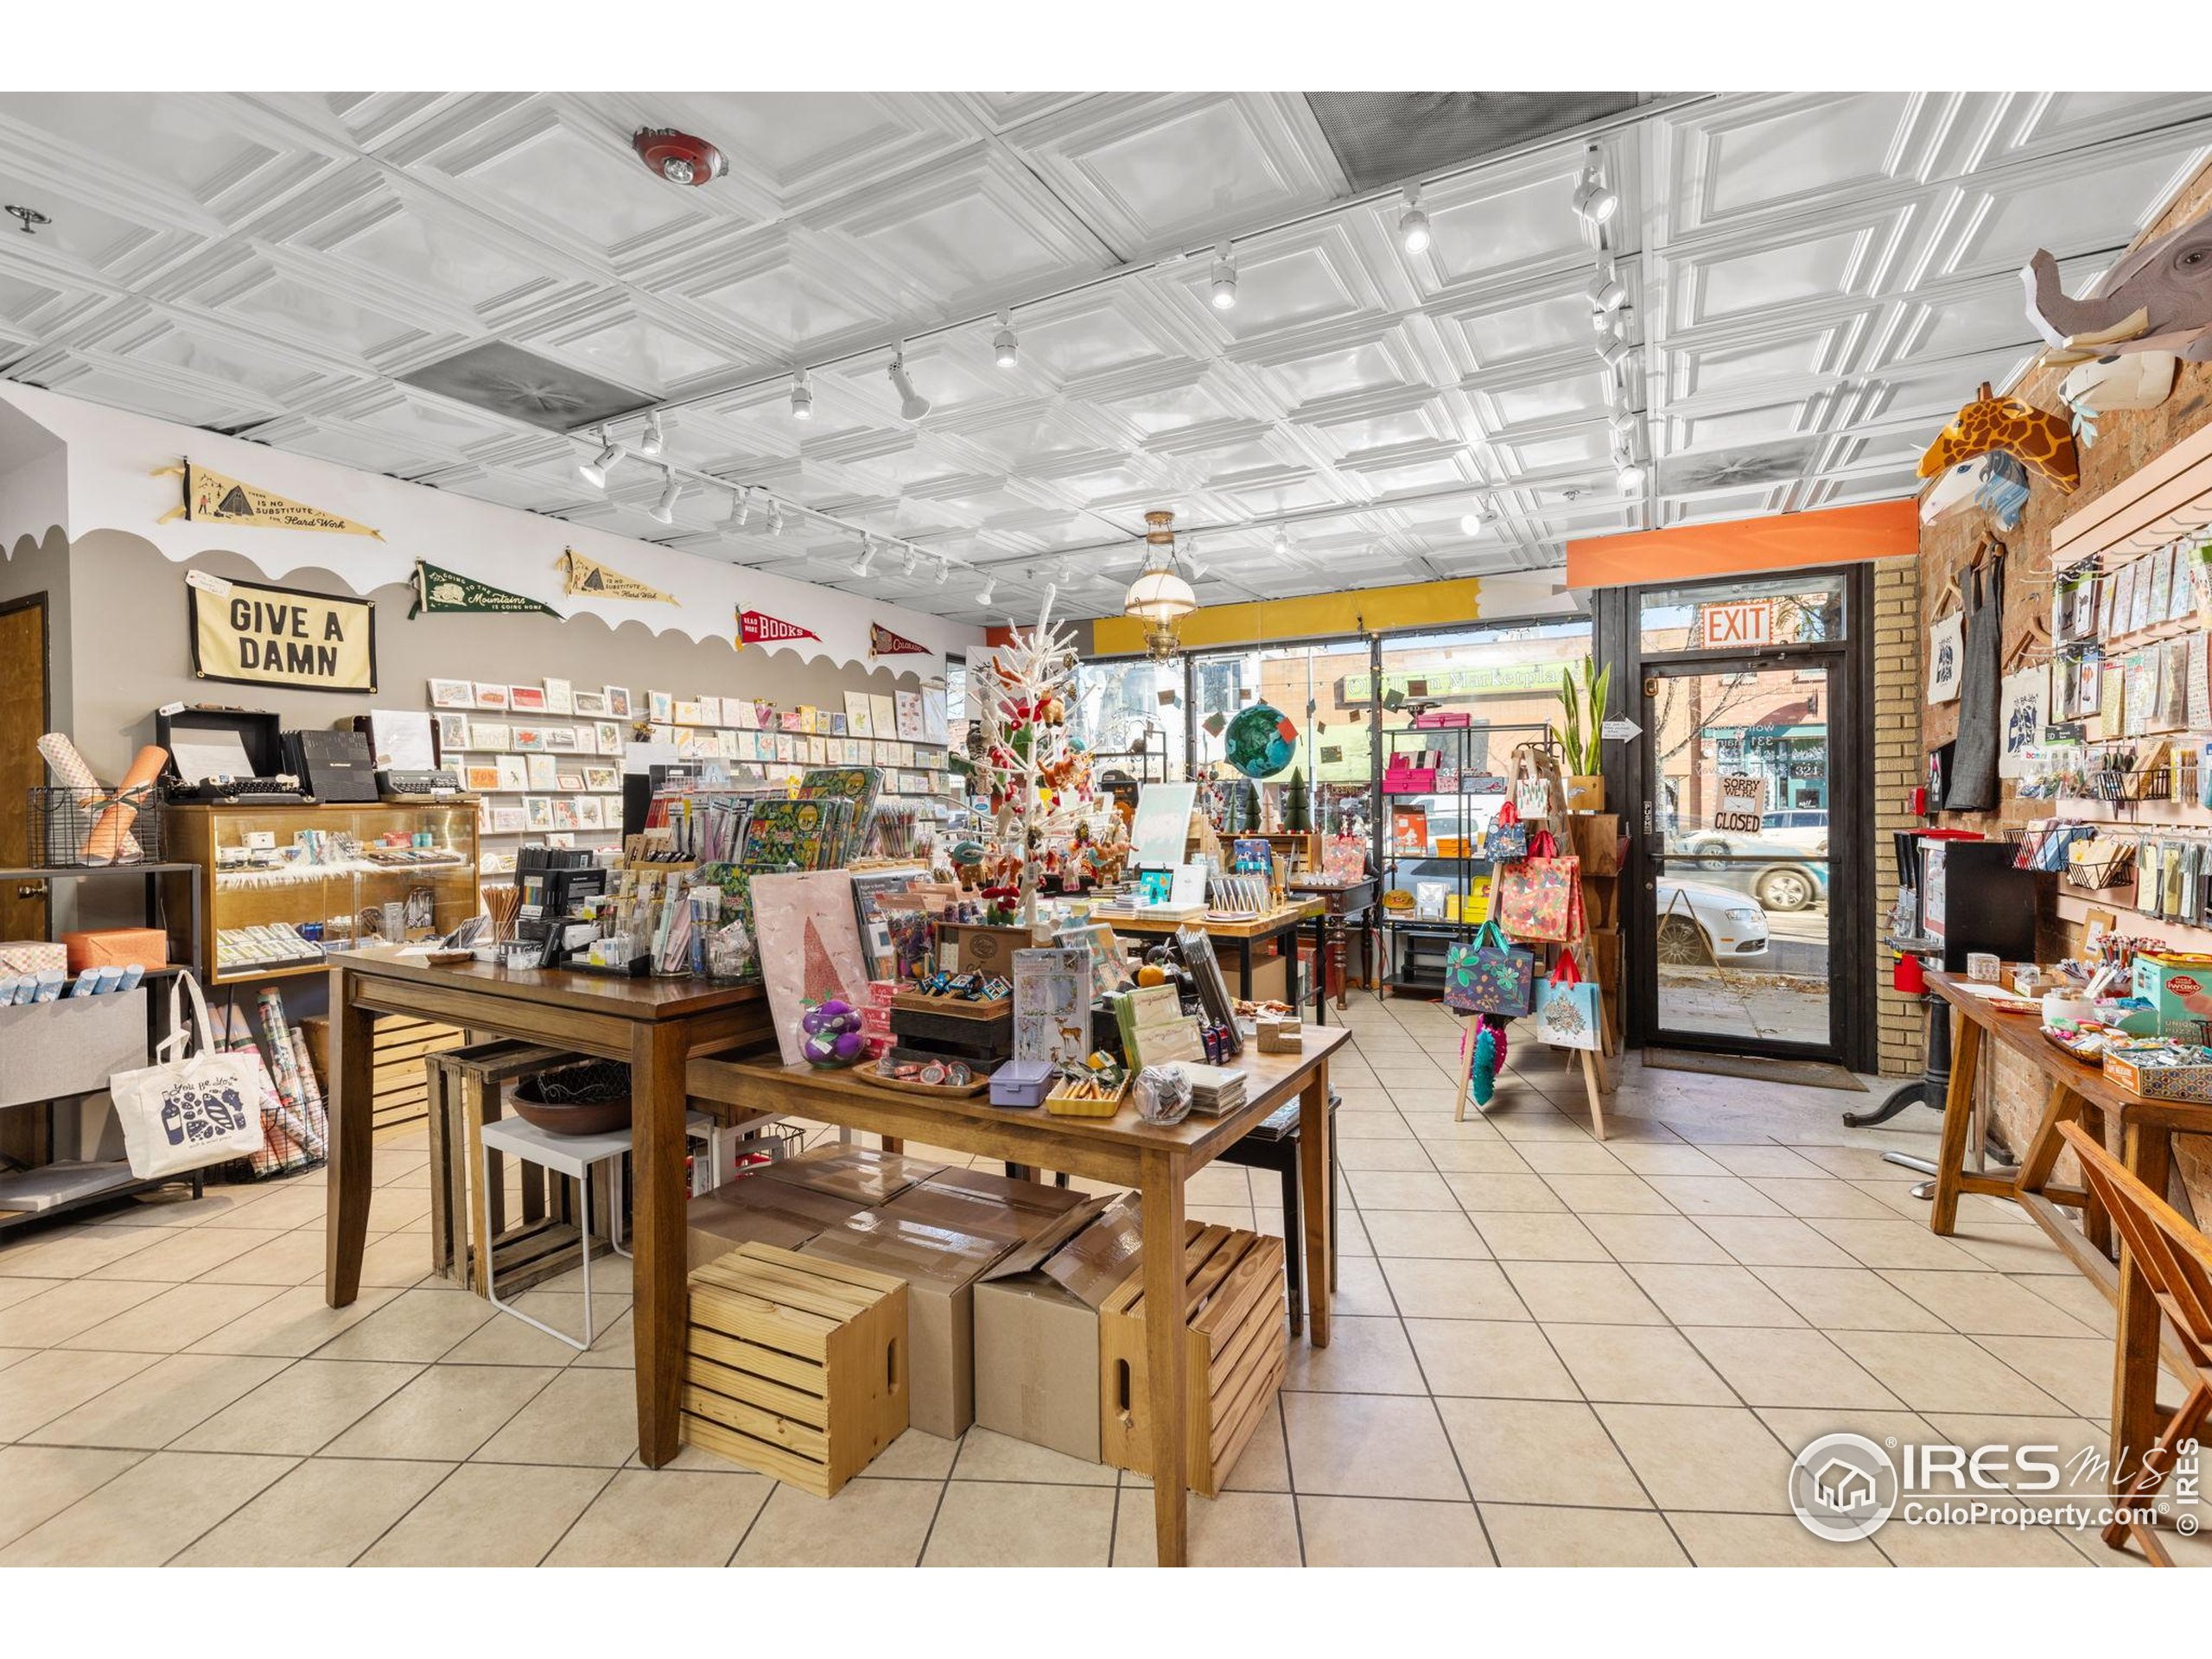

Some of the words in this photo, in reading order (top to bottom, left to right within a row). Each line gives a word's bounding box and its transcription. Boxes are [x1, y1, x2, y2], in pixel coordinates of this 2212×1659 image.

[284, 515, 317, 527] Hard
[316, 518, 346, 529] Work
[443, 573, 466, 584] GOING
[477, 584, 492, 594] THE
[467, 593, 526, 607] Mountains
[230, 598, 309, 639] GIVE
[324, 612, 344, 642] A
[759, 615, 804, 639] BOOKS
[1708, 607, 1765, 643] EXIT
[238, 636, 338, 677] DAMN
[1724, 778, 1760, 790] SORRY
[1714, 811, 1760, 833] CLOSED
